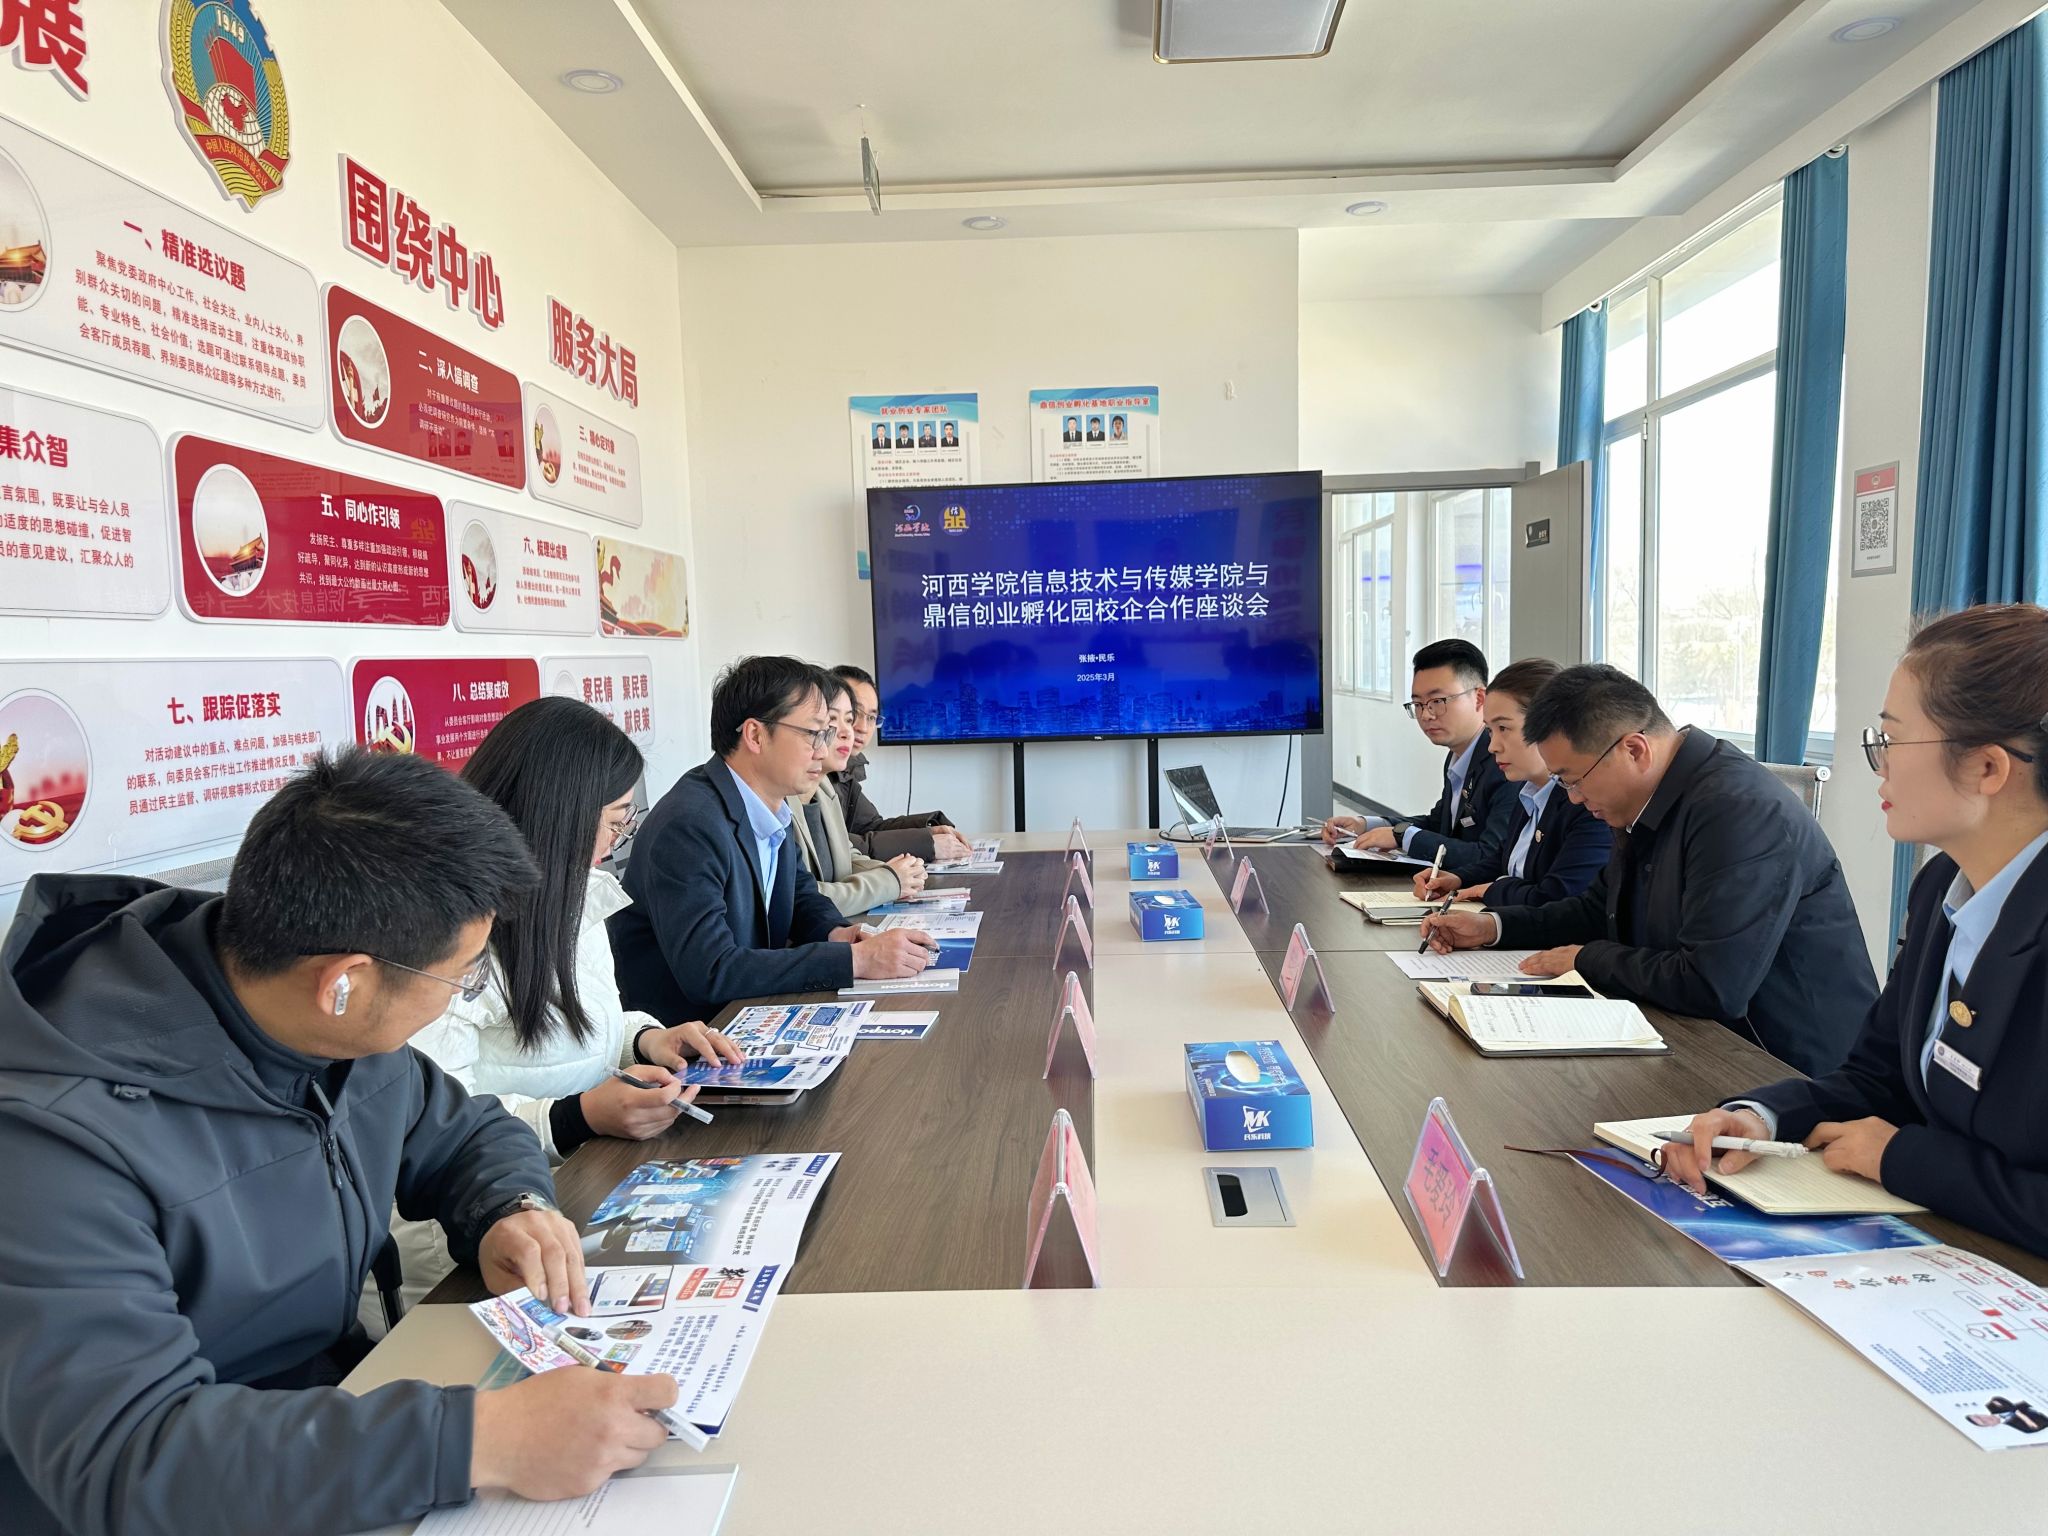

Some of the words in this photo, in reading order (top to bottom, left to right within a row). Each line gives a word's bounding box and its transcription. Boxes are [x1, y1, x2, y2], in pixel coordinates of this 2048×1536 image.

[216, 10, 245, 43] 1949
[206, 138, 270, 190] 中国人民政治协商会议
[123, 220, 246, 292] 一、精准选议题
[347, 157, 504, 328] 围绕中心
[551, 298, 639, 407] 服务大局
[418, 349, 480, 394] 二、深入搞调查
[0, 484, 130, 518] 言氛围，既要让与会人员
[320, 492, 400, 530] 五、同心作引领
[921, 561, 1270, 598] 河西学院信息技术与传媒学院与
[923, 593, 1271, 627] 鼎信创业孵化园校企合作座谈会
[452, 680, 510, 702] 八、总结聚成效
[582, 677, 613, 704] 察民情
[622, 673, 649, 701] 聚民意
[1077, 672, 1115, 682] 2025年3月
[167, 692, 282, 725] 七、跟踪促落实
[624, 706, 651, 735] 献良策
[144, 730, 322, 763] 对活动建议中的重点、难点问题，加强与相关部门
